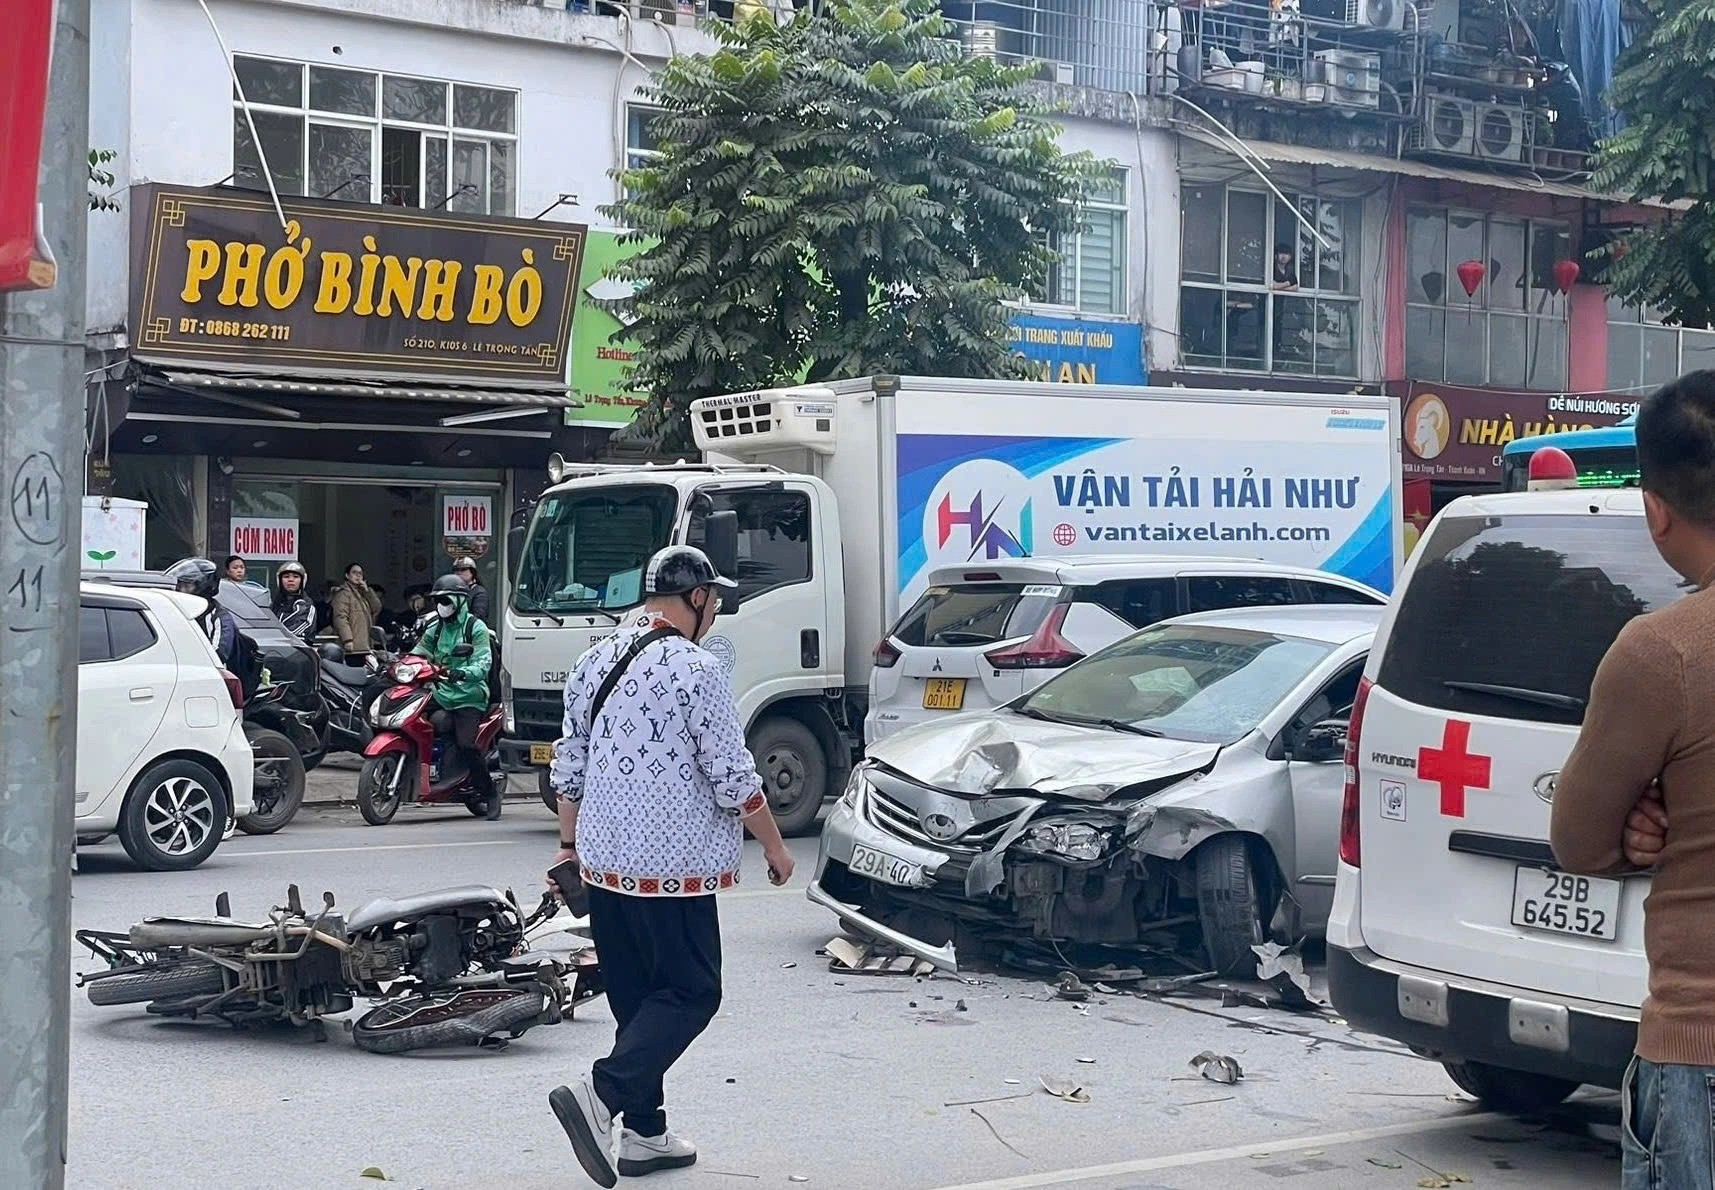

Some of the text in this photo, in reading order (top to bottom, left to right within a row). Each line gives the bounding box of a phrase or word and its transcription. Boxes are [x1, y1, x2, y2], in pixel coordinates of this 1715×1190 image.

[180, 219, 543, 328] PHỞ BÌNH BÒ
[205, 319, 240, 337] 0868
[241, 322, 268, 340] 262
[270, 324, 291, 341] 111
[1025, 326, 1059, 346] TRANG
[1060, 325, 1086, 348] XUẤT
[1086, 327, 1113, 349] KHẨU
[701, 393, 762, 408] THERMAL MASTER
[1548, 394, 1565, 411] DÊ
[1565, 395, 1584, 412] NÚI
[1584, 399, 1621, 415] HƯƠNG
[1458, 413, 1515, 446] NHÀ
[1052, 466, 1361, 514] VẬN TẢI HẢI NHƯ
[447, 500, 486, 532] PHỞ BÒ
[234, 523, 295, 555] CƠM RANG
[1084, 521, 1331, 542] vantaixelanh.com
[540, 671, 570, 683] ISUZ
[1371, 752, 1417, 769] HYUNDAI
[1543, 872, 1590, 904] 29B
[1522, 899, 1606, 937] 645.52
